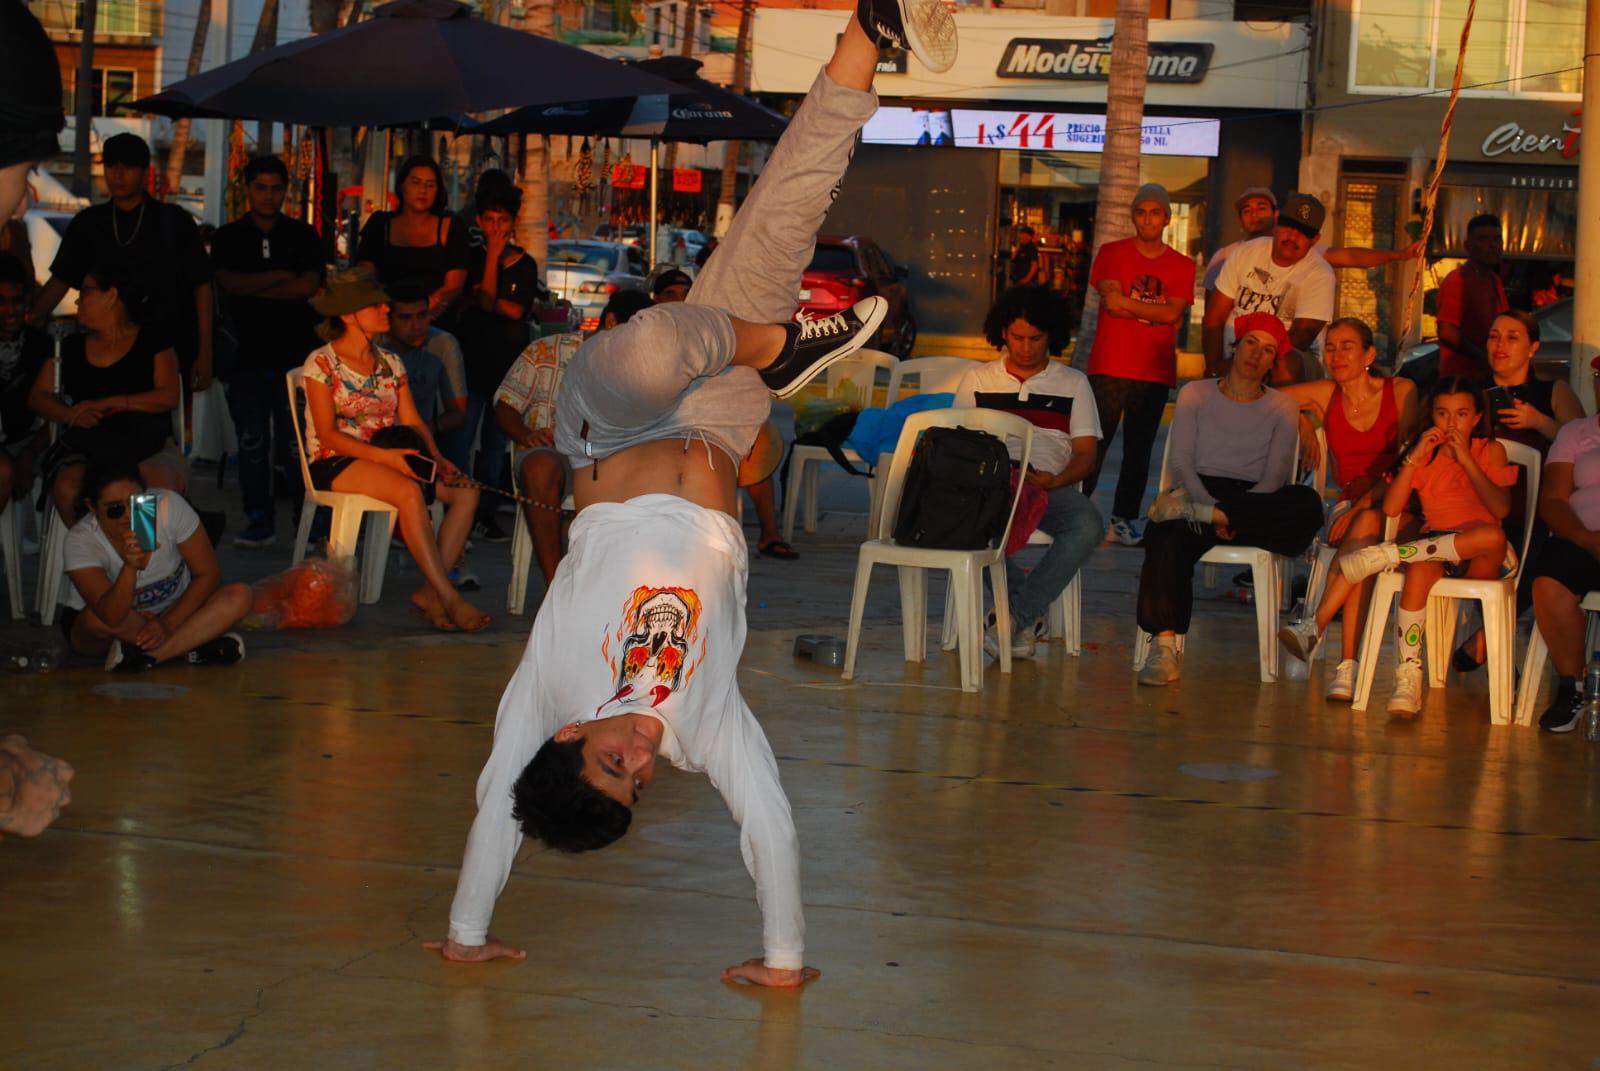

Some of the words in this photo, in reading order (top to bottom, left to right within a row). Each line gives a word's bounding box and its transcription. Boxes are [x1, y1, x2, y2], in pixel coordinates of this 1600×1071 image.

[1007, 44, 1198, 77] Modelma
[672, 108, 734, 119] Corona
[1067, 123, 1100, 133] PRECIO
[1143, 126, 1171, 136] TELLA
[1066, 134, 1105, 144] SUGERI
